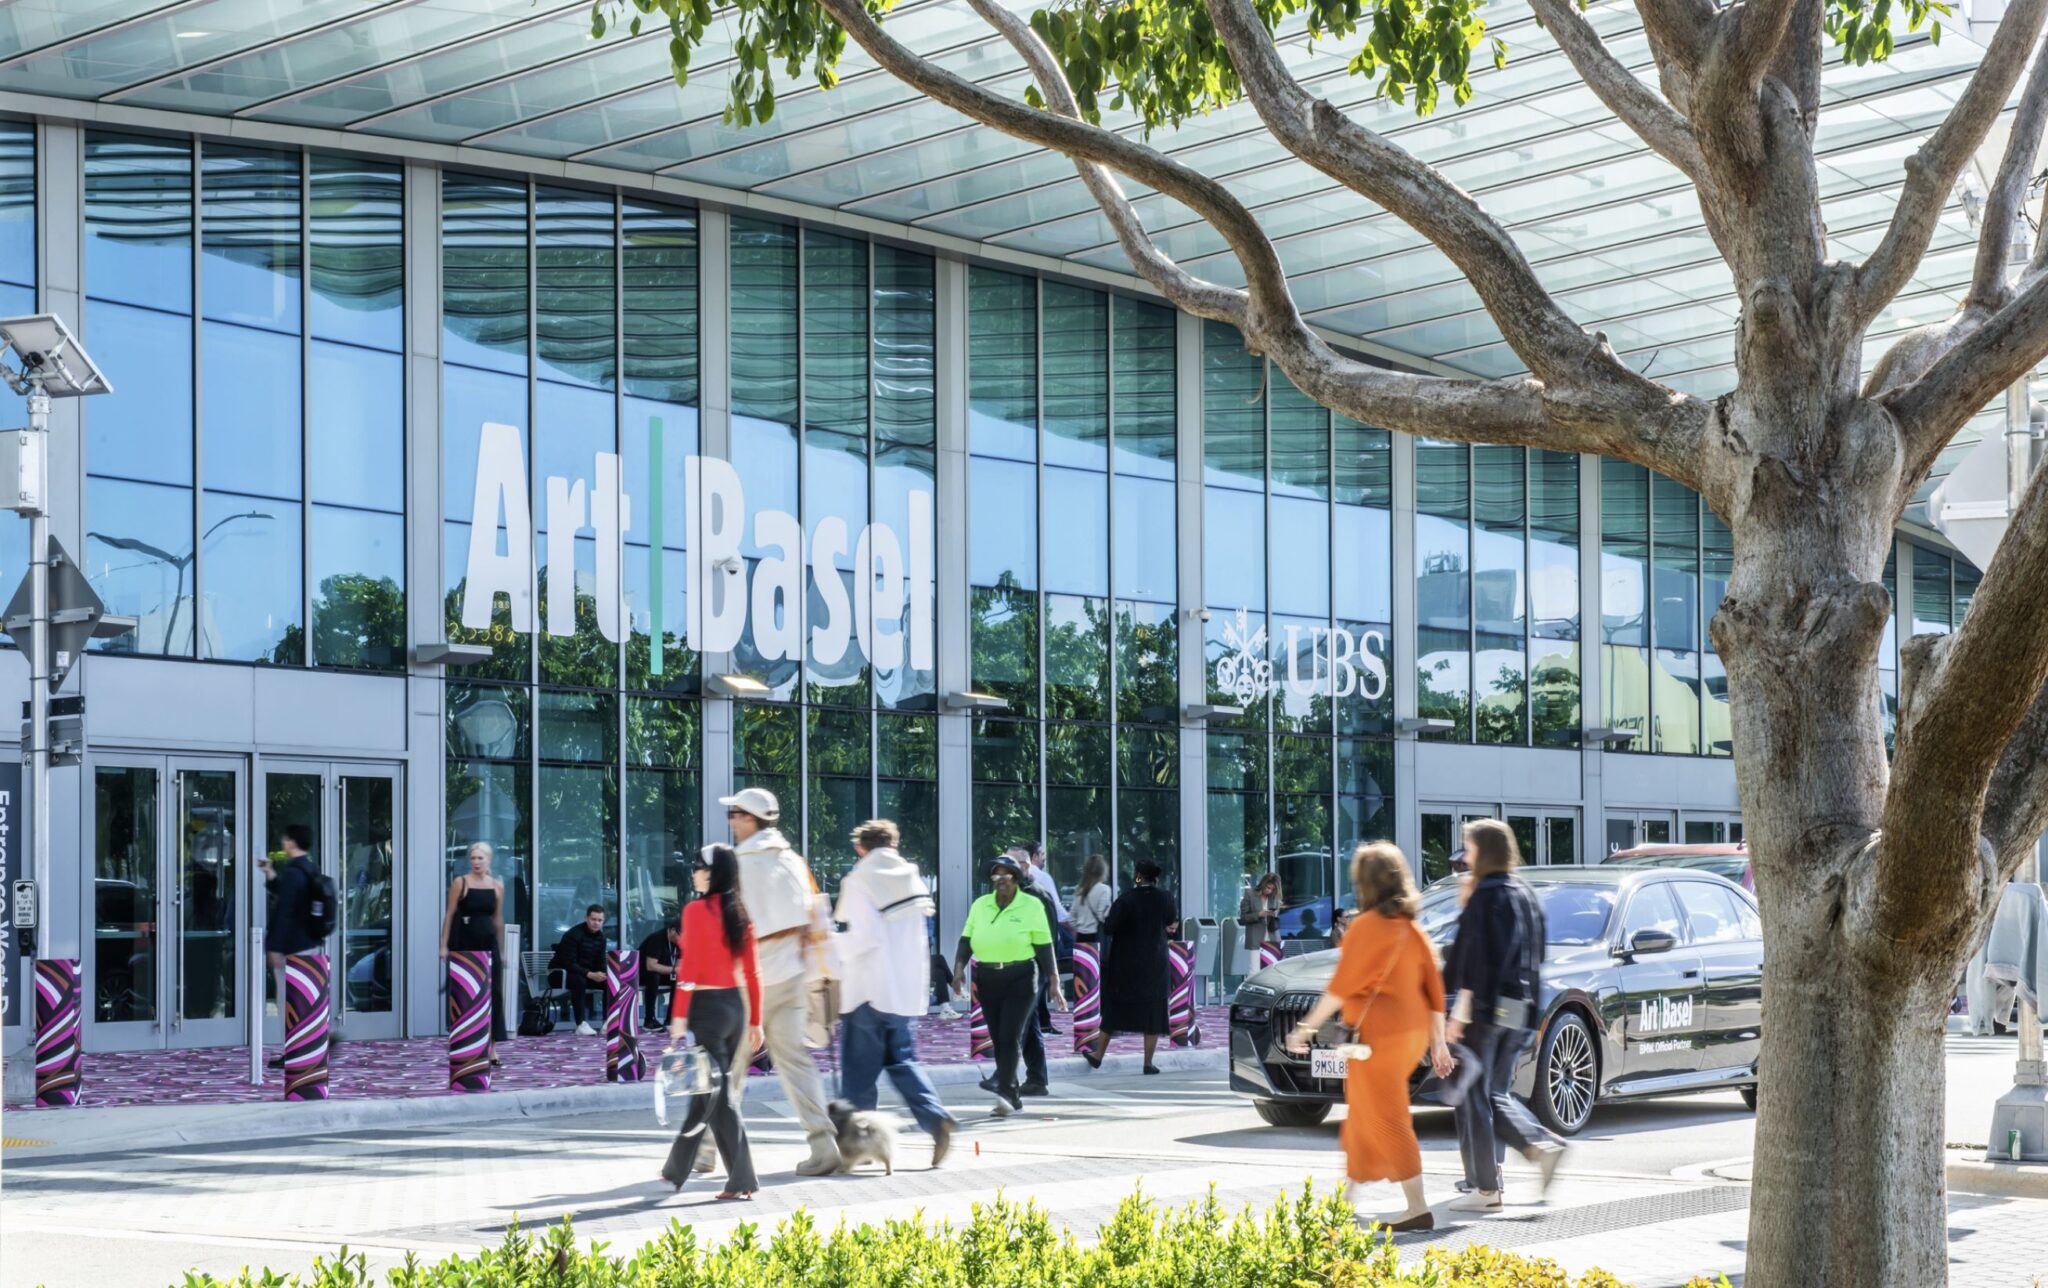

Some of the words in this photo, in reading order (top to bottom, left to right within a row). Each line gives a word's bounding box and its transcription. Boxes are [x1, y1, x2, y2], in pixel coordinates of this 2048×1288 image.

[461, 422, 631, 644] Art
[685, 455, 933, 671] Basel
[1284, 625, 1387, 700] UBS
[1639, 999, 1658, 1032] Art
[1662, 994, 1693, 1029] Basel
[1655, 1040, 1673, 1053] Official
